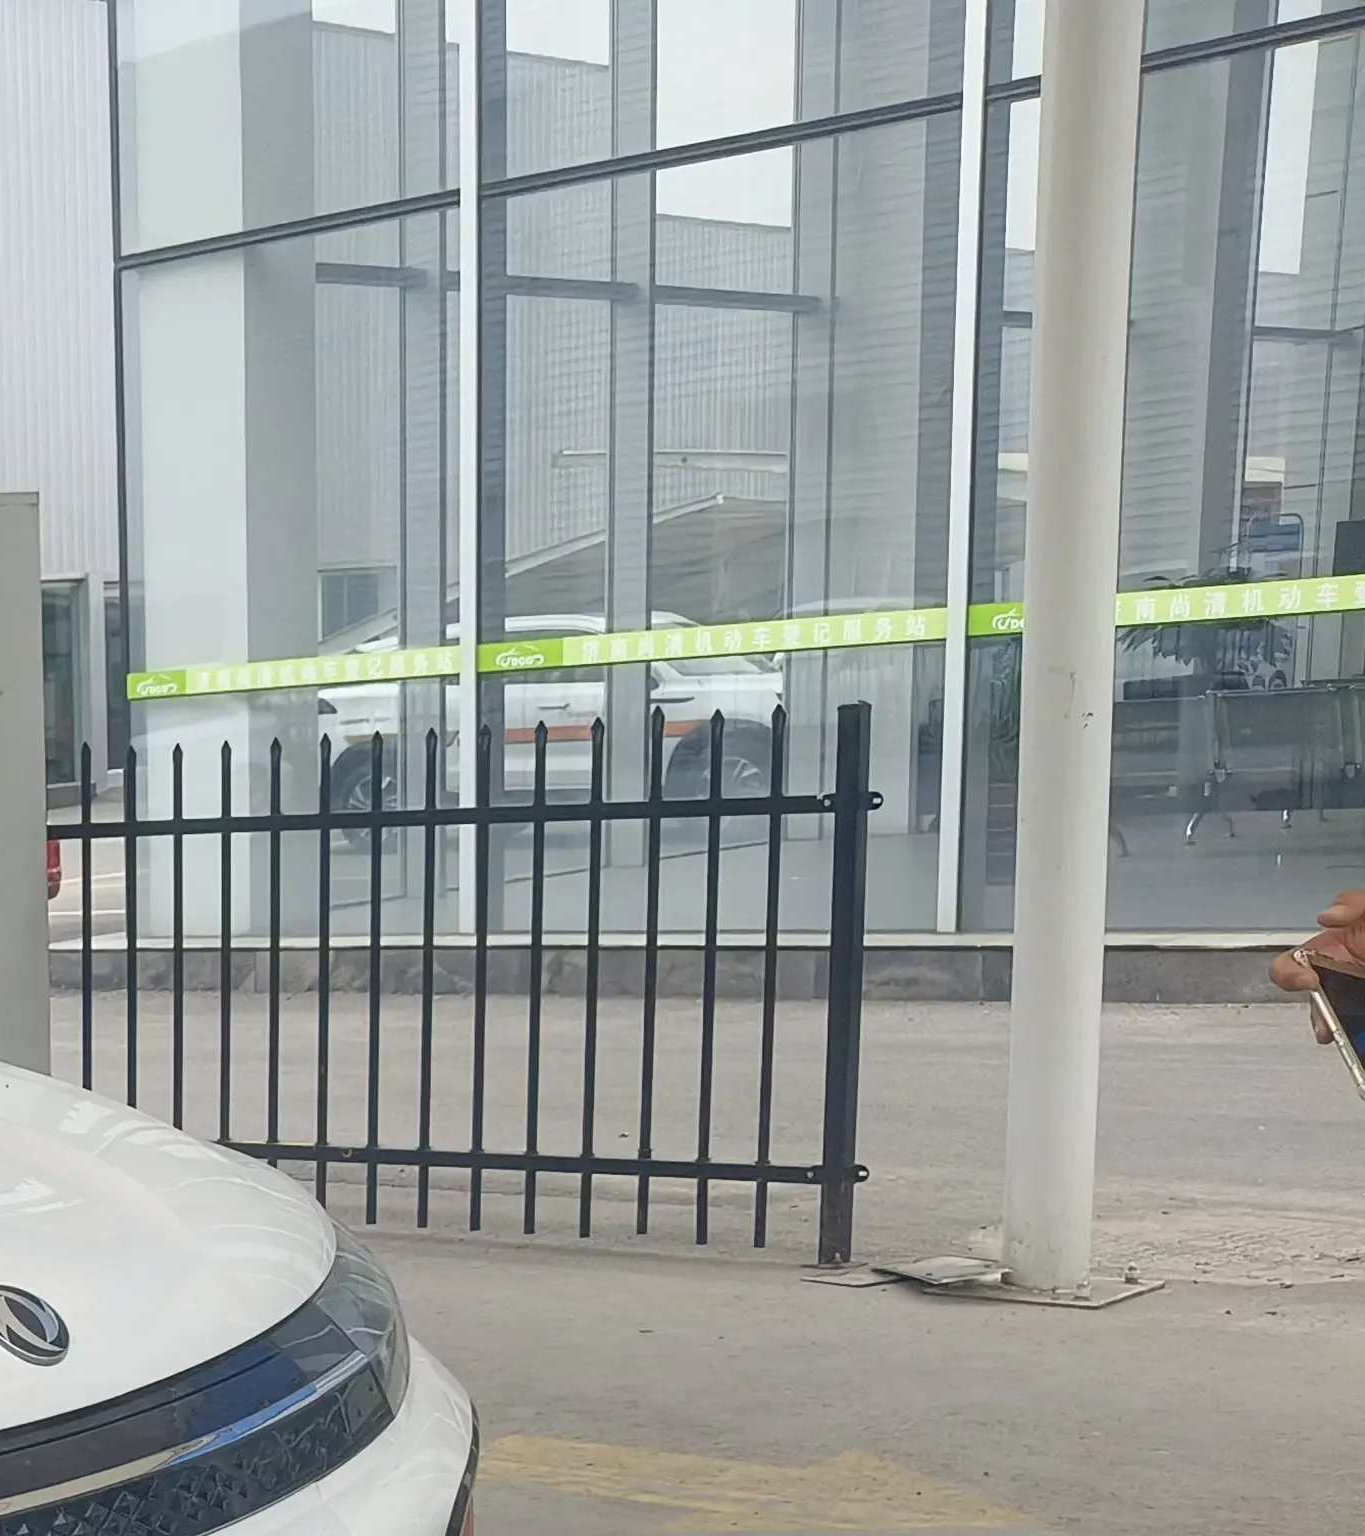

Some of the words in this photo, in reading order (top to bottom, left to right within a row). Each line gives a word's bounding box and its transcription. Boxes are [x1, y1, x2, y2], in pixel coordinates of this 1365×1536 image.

[1116, 581, 1365, 621] 南尚清机动车
